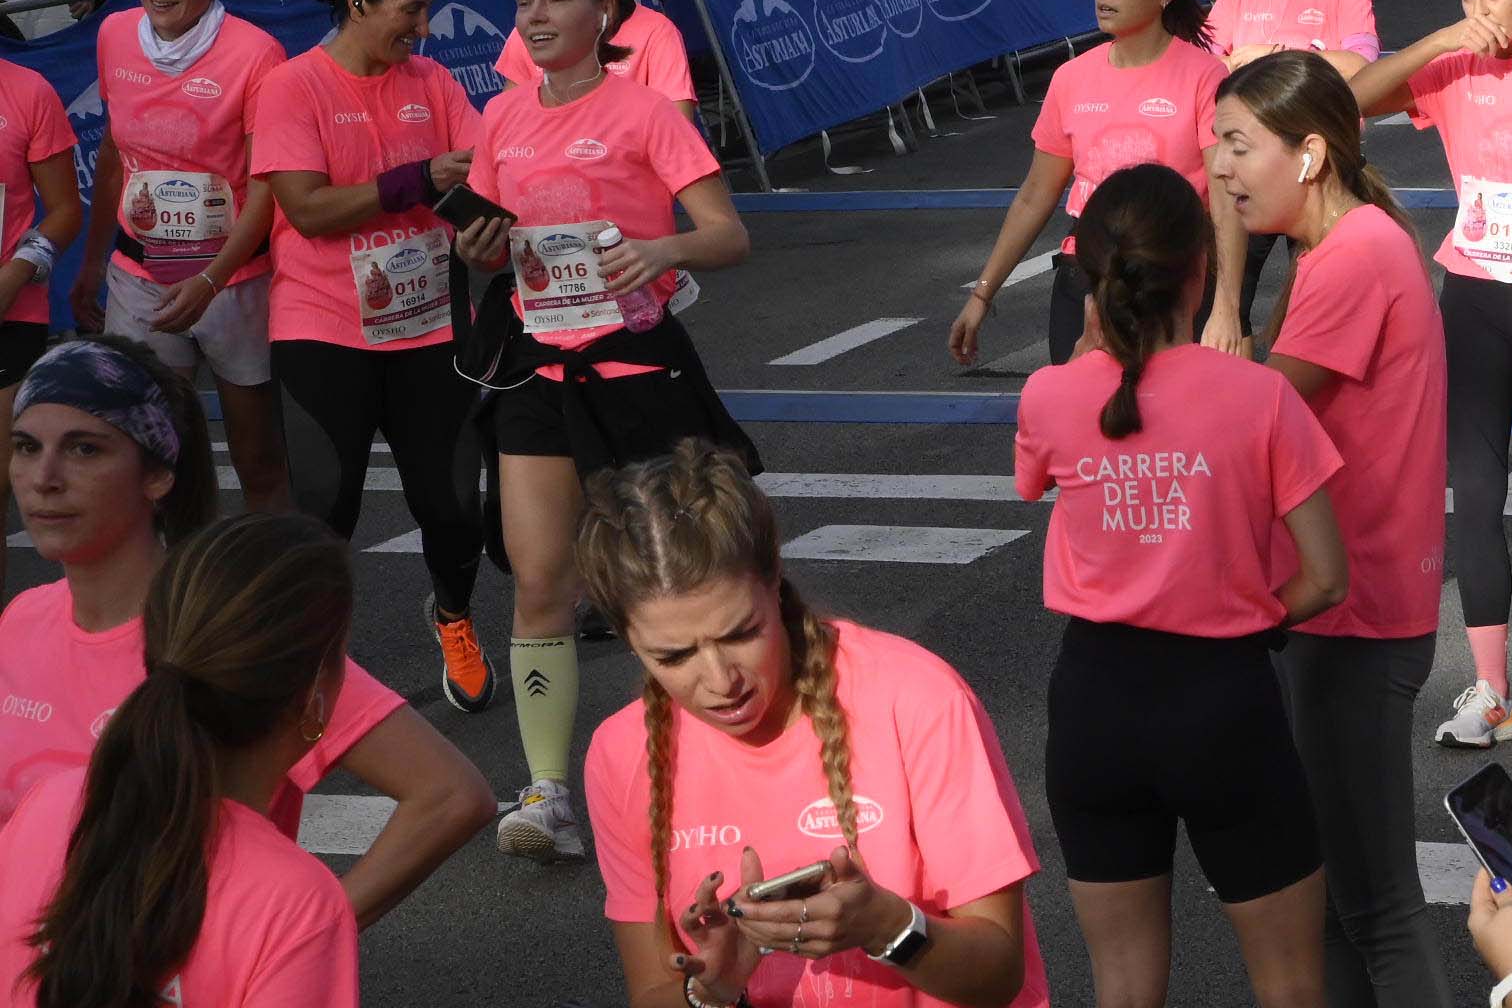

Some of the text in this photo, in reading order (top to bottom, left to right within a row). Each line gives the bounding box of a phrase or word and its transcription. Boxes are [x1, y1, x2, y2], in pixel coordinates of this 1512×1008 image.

[115, 67, 152, 85] OYSHO
[158, 186, 197, 199] ASTURIANA
[160, 211, 196, 225] 016
[164, 229, 192, 239] 11577
[541, 240, 583, 254] ASTURIANA
[551, 262, 588, 280] 016
[395, 275, 428, 296] 016
[558, 282, 586, 294] 17786
[401, 294, 426, 308] 16914
[534, 298, 562, 308] CARRERA
[573, 296, 582, 304] LA
[582, 294, 604, 303] MUJER
[534, 314, 564, 325] OYSHO
[372, 325, 407, 339] OYSHO
[1077, 451, 1213, 481] CARRERA
[1104, 479, 1188, 506] DE LA
[1101, 503, 1192, 532] MUJER
[1138, 534, 1164, 545] 2023
[2, 694, 53, 723] OYSHO
